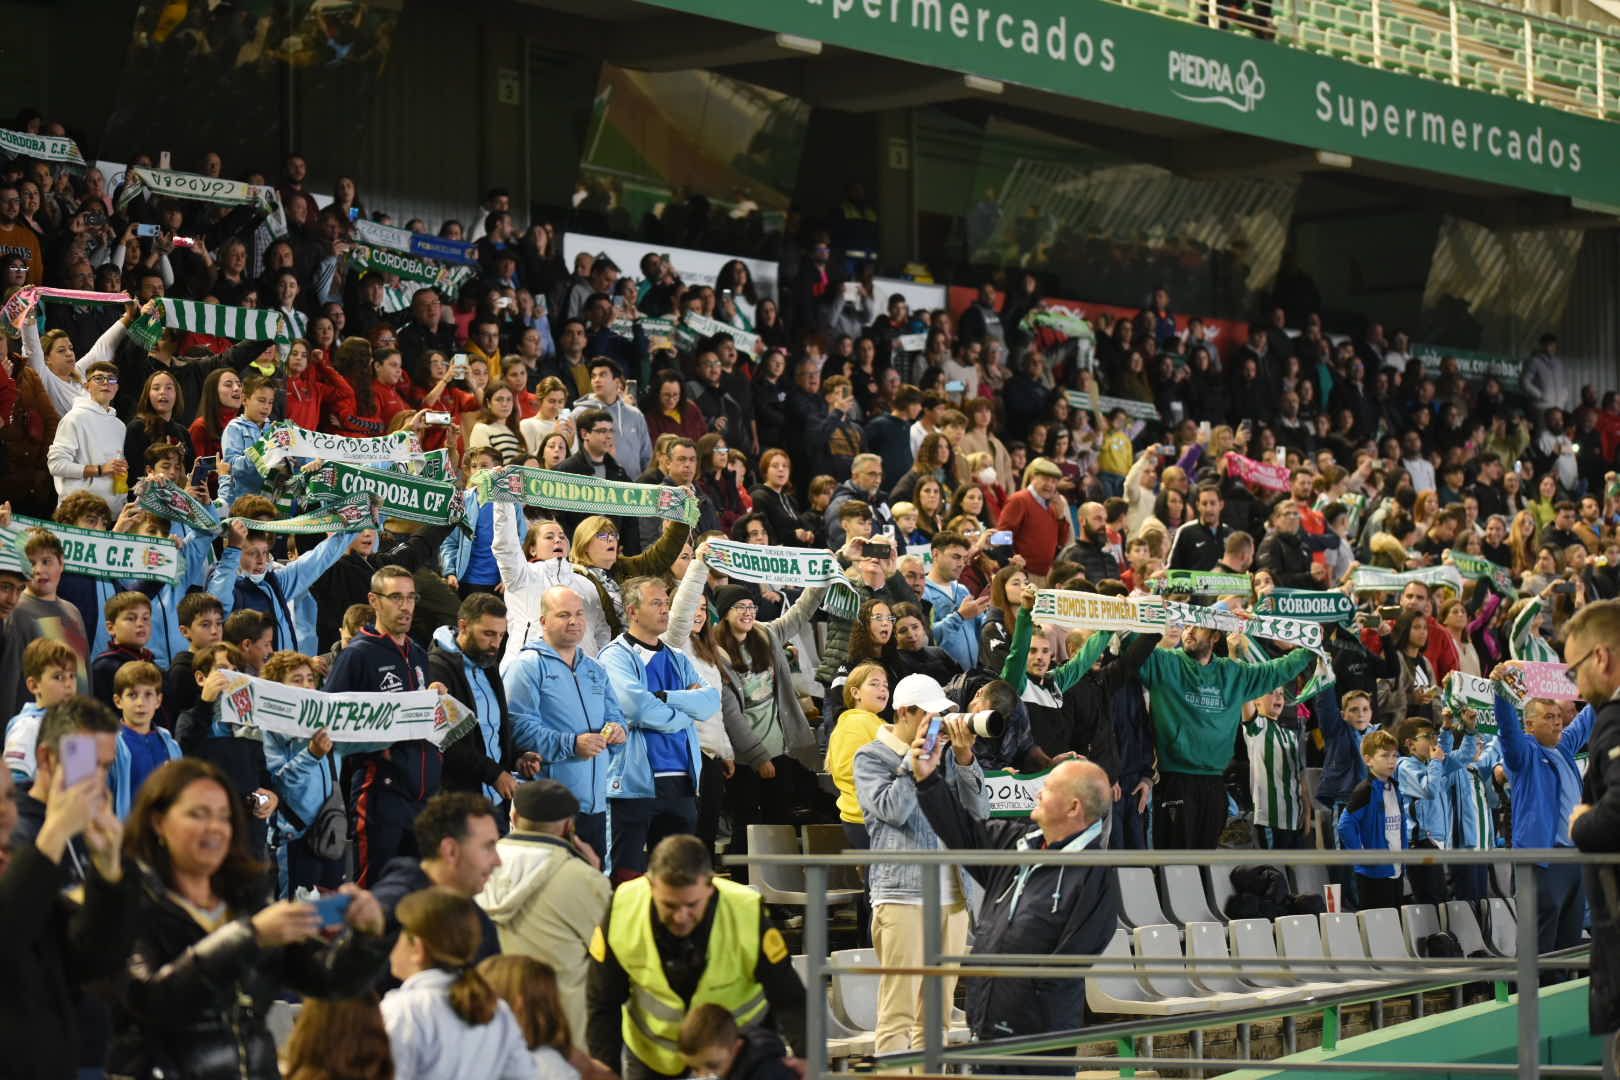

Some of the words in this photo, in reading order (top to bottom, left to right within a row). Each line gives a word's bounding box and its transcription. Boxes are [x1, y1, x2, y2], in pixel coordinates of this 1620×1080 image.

[1316, 81, 1582, 172] Supermercados
[341, 470, 419, 508] CÓRDOBA
[424, 493, 446, 513] CF
[106, 545, 134, 568] C.F.
[732, 551, 801, 575] CÓRDOBA
[1057, 599, 1087, 617] SOMOS
[1088, 601, 1100, 618] DE
[1101, 602, 1138, 622] PRIMERA
[298, 699, 400, 731] VOLVEREMOS
